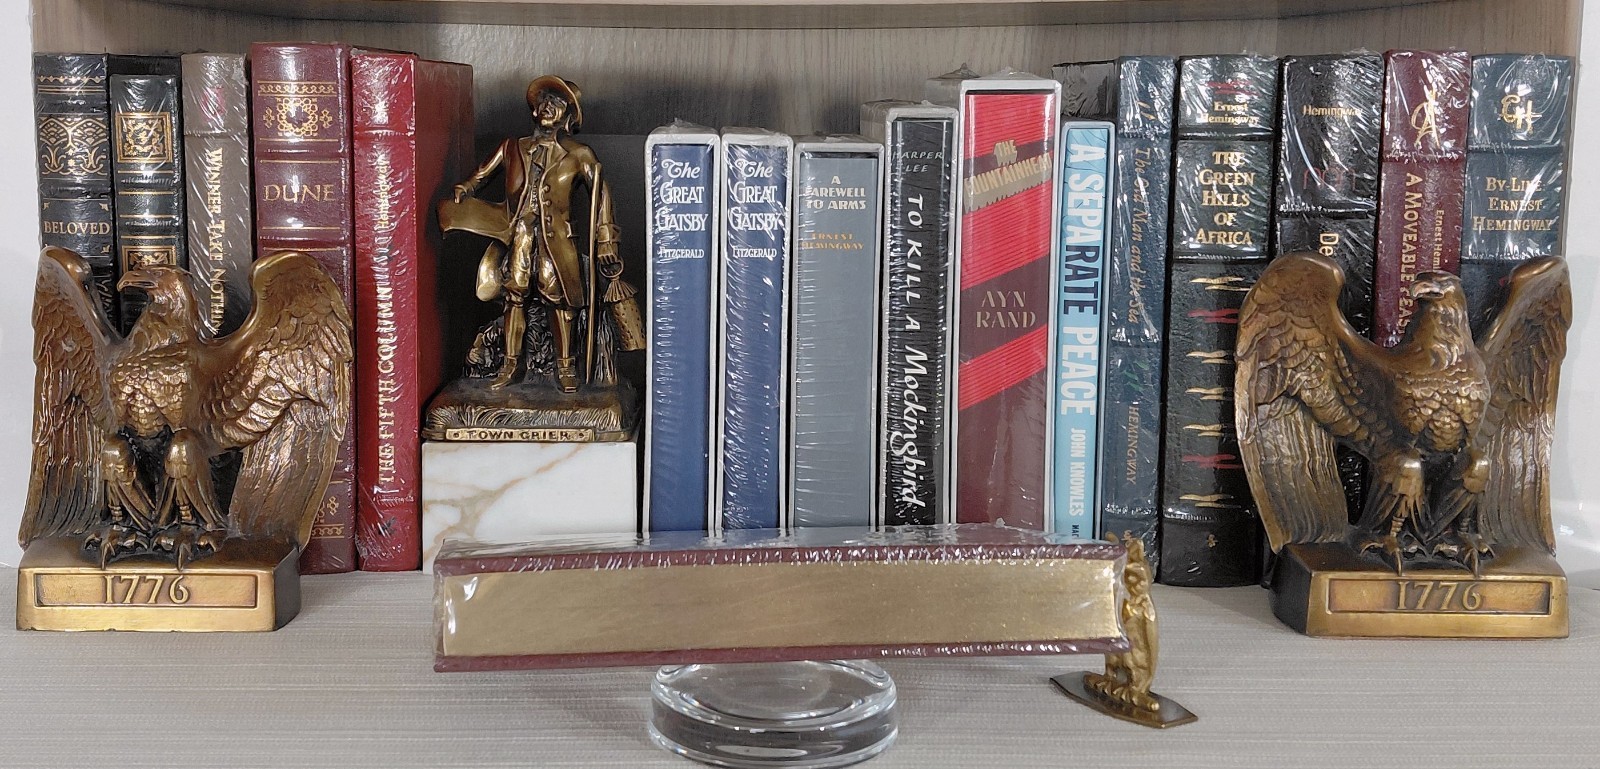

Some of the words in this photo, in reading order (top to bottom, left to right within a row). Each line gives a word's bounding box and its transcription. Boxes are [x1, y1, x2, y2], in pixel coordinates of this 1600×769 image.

[1214, 101, 1249, 112] Ernest
[1303, 105, 1362, 118] Hemingway
[1202, 113, 1260, 125] Hemingway
[1070, 143, 1106, 164] A
[1135, 147, 1151, 174] The
[1212, 151, 1246, 166] THE
[661, 158, 701, 179] The
[735, 158, 773, 178] The
[905, 164, 928, 172] LEE
[1199, 169, 1255, 186] GREEN
[206, 148, 223, 214] WINNER
[831, 175, 841, 185] A
[1405, 172, 1423, 186] A
[263, 184, 335, 202] DUNE
[659, 180, 704, 204] GREAT
[733, 181, 777, 204] GREAT
[805, 187, 866, 198] FAREWELL
[805, 200, 824, 209] TO
[828, 200, 866, 210] ARMS
[907, 193, 923, 228] TO
[1488, 196, 1543, 211] ERNEST
[43, 221, 110, 235] BELOVED
[656, 206, 708, 231] GATSBY
[730, 206, 781, 231] GATSBY
[1131, 207, 1148, 243] Man
[1214, 212, 1237, 226] OF
[1433, 209, 1445, 242] Ernest
[1472, 216, 1552, 231] HEMINGWAY
[209, 219, 226, 261] TAKE
[1063, 173, 1103, 315] SEPARATE
[1195, 229, 1252, 246] AFRICA
[1400, 191, 1423, 282] MOVEABLE
[659, 247, 704, 259] FITZGERALD
[732, 247, 777, 258] FITZGERALD
[1130, 245, 1146, 274] and
[1432, 243, 1443, 272] Hemi
[906, 238, 923, 304] KILL
[1129, 276, 1146, 297] the
[210, 268, 227, 330] NOTHIN
[981, 290, 1026, 308] AYN
[976, 311, 1036, 328] RAND
[1128, 299, 1144, 324] Sea
[905, 315, 921, 330] A
[1060, 326, 1098, 416] PEACE
[378, 378, 395, 439] FIFTH
[466, 429, 514, 440] TOWN
[519, 429, 571, 440] CRIER
[889, 345, 928, 507] Mockingbird
[1070, 428, 1086, 457] JOHN
[1126, 406, 1140, 485] HEMINGWAY
[378, 445, 394, 485] THE
[1069, 462, 1085, 517] KNOWLES
[1071, 524, 1080, 538] MAC
[102, 574, 191, 605] 1776
[1396, 580, 1483, 611] 1776
